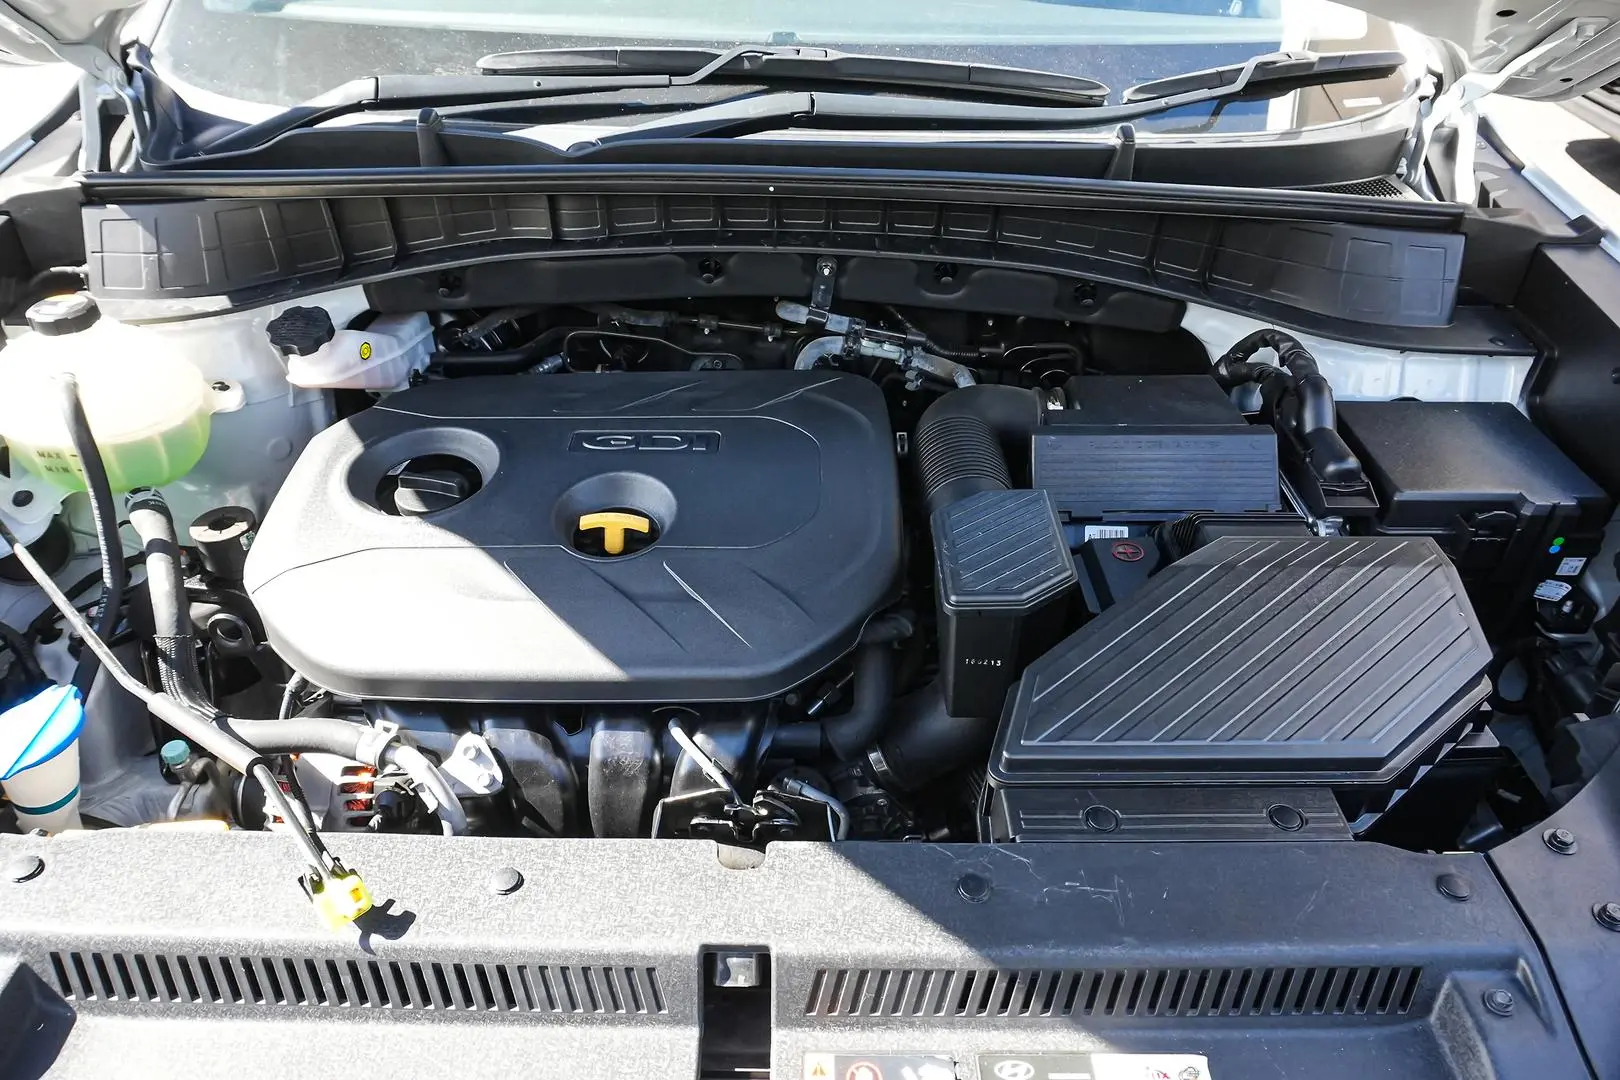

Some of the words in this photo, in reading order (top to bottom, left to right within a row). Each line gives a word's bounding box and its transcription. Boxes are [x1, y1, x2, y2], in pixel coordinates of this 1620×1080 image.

[581, 434, 707, 451] GDI
[37, 450, 62, 460] MAX
[44, 464, 70, 473] MIN
